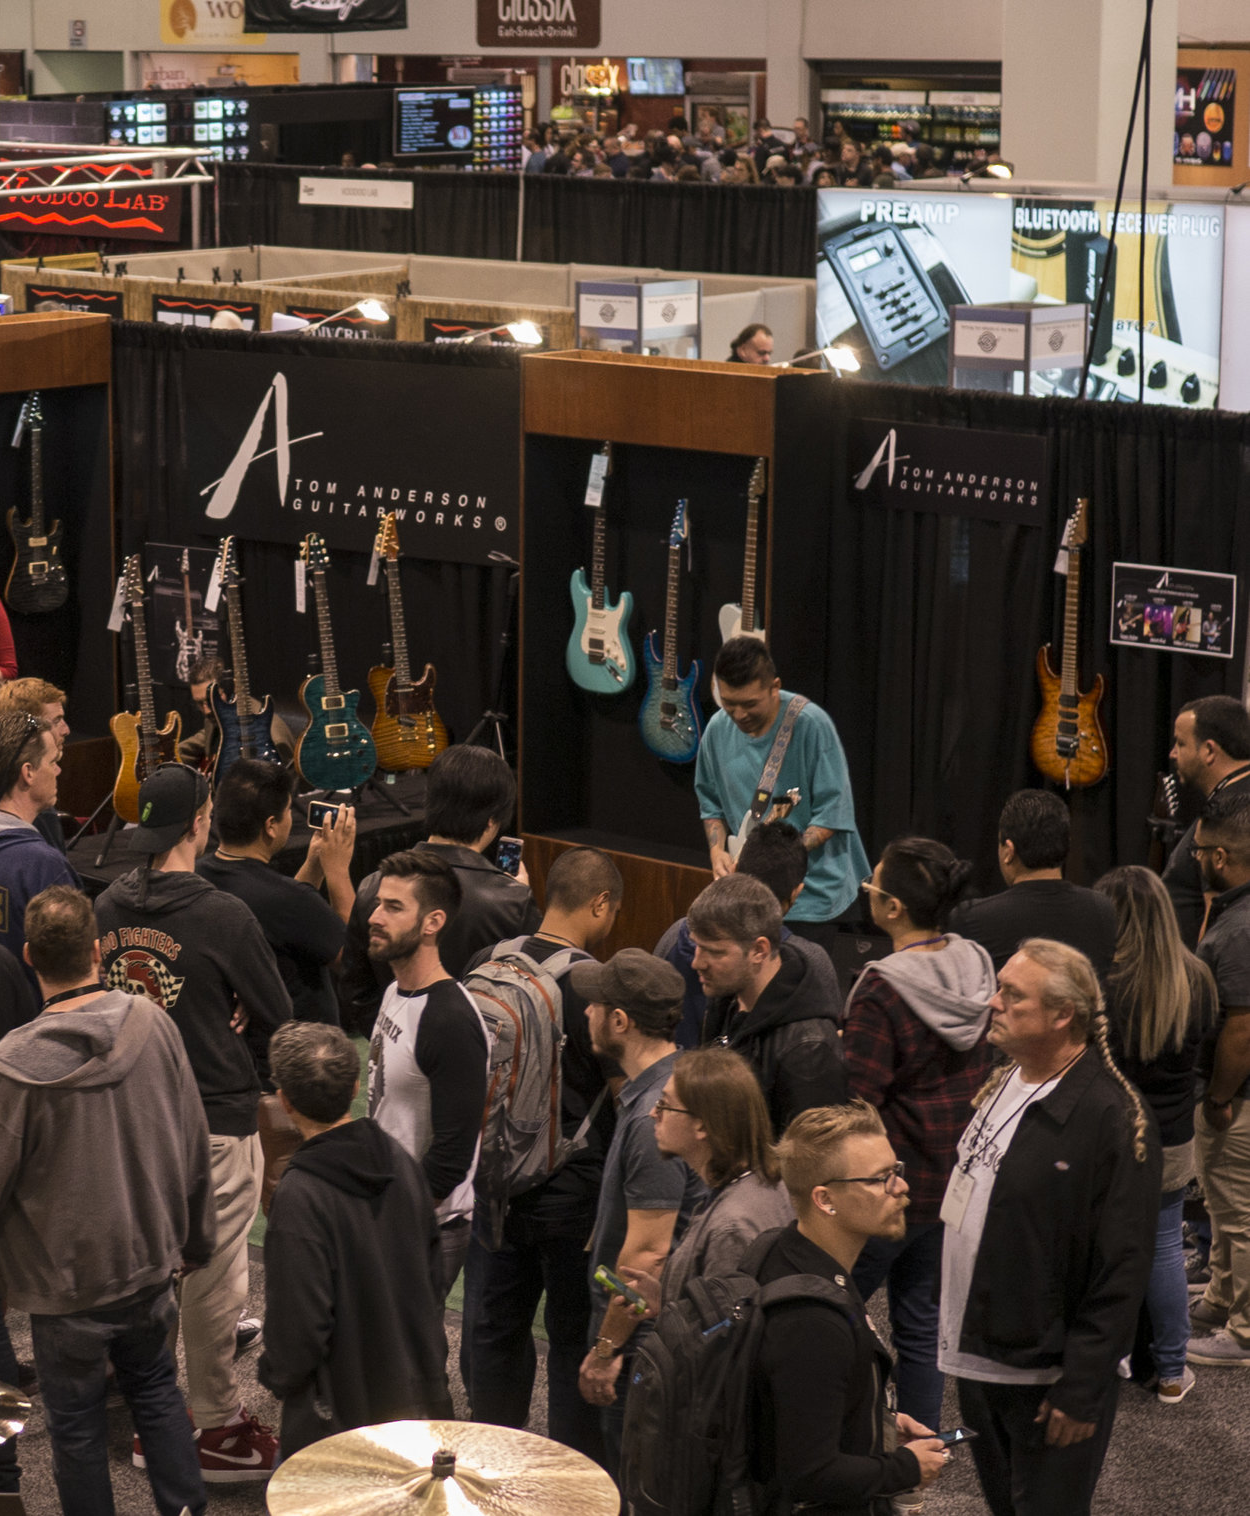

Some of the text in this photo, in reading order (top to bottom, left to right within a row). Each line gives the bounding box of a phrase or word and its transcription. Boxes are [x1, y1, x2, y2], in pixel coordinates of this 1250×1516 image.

[859, 200, 961, 225] PREAMP
[1014, 207, 1100, 233] BLUETOOTH
[1180, 215, 1222, 237] PLUG
[294, 478, 487, 509] TOM ANDERSON
[899, 480, 1038, 507] GUITARWORKS
[901, 465, 1038, 492] TOM ANDERSON
[292, 497, 483, 529] GUITARWORKS
[118, 927, 183, 961] FIGHTERS
